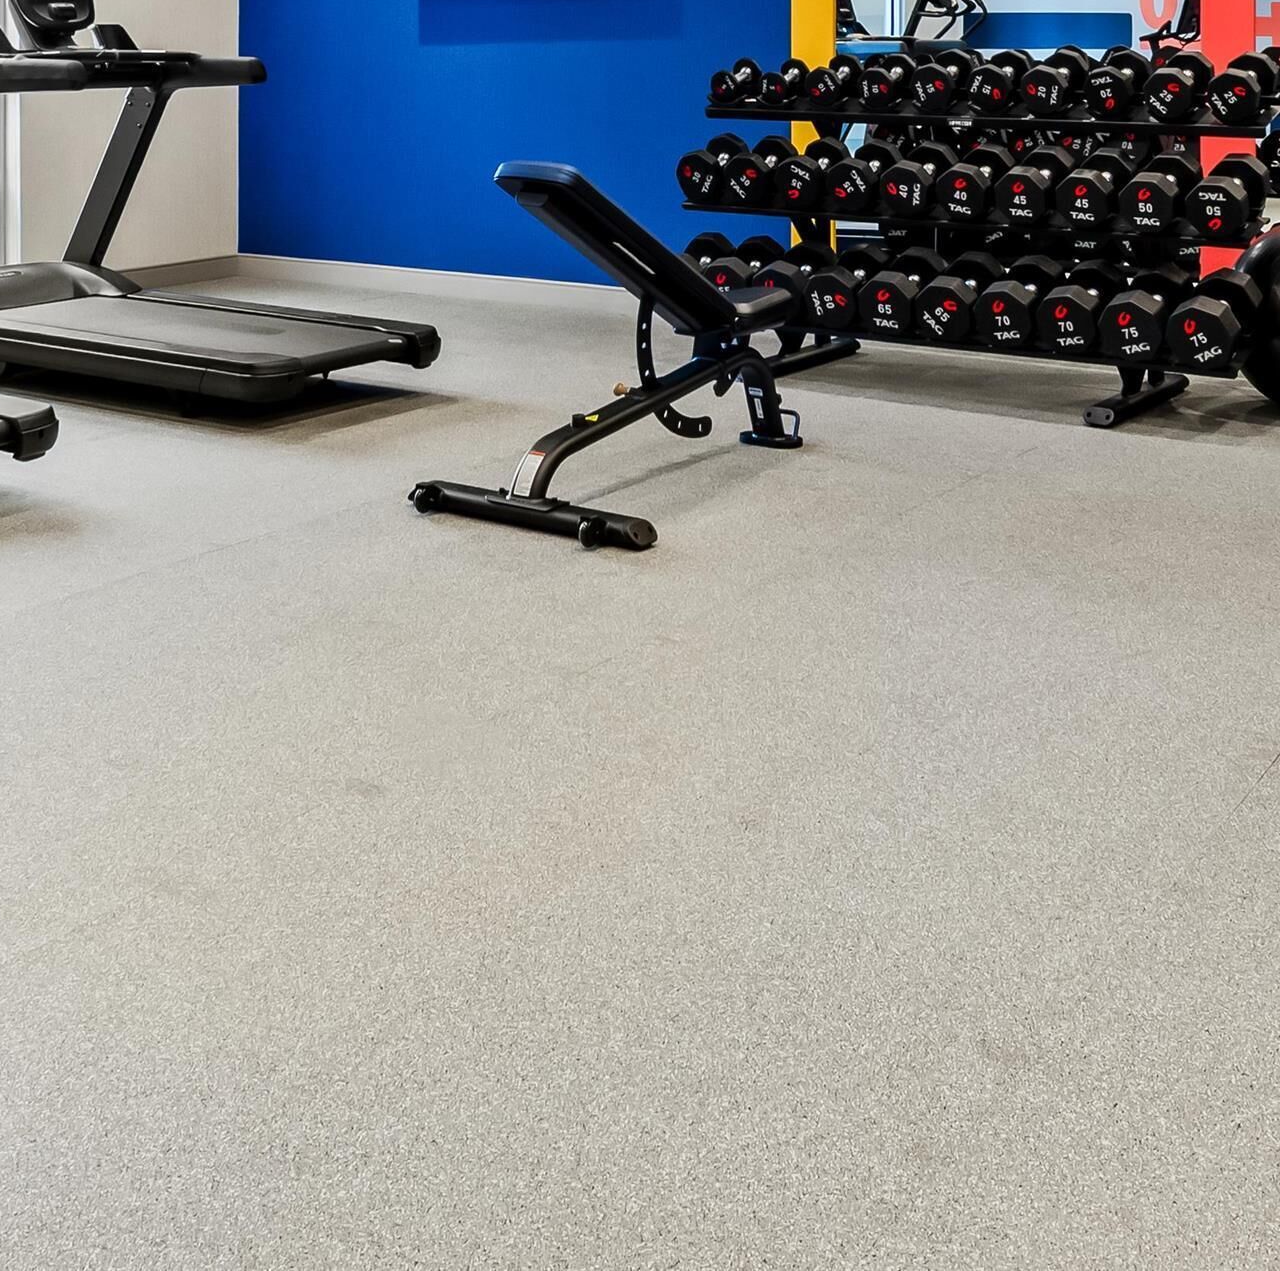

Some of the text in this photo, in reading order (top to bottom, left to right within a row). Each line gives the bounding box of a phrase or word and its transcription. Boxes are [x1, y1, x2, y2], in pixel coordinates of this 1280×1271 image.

[970, 74, 983, 94] TAG
[1091, 76, 1113, 86] TAG
[871, 84, 880, 94] 10
[914, 81, 928, 102] TAG
[926, 83, 935, 95] 15
[982, 84, 992, 96] 15
[1037, 85, 1047, 98] 20
[1049, 84, 1059, 106] TAG
[1099, 88, 1113, 98] 20
[1159, 89, 1174, 103] 25
[1223, 90, 1238, 105] 25
[1148, 96, 1168, 115] TAG
[1209, 93, 1228, 116] TAG
[692, 171, 702, 183] 30
[790, 164, 811, 181] TAG
[701, 174, 713, 193] TAG
[739, 174, 751, 187] 30
[791, 178, 802, 189] 35
[850, 169, 867, 193] TAG
[729, 179, 747, 199] TAG
[842, 181, 855, 194] 35
[898, 184, 908, 199] 40
[912, 183, 921, 206] TAG
[953, 190, 968, 201] 40
[1013, 195, 1027, 205] 45
[1198, 191, 1227, 202] TAG
[948, 202, 972, 215] TAG
[1074, 198, 1089, 209] 45
[1138, 202, 1153, 214] 50
[1009, 208, 1033, 218] TAG
[1069, 211, 1095, 221] TAG
[1205, 205, 1222, 217] 50
[1133, 216, 1161, 227] TAG
[810, 290, 824, 316] TAG
[823, 295, 835, 310] 60
[877, 303, 893, 315] 65
[934, 306, 951, 323] 65
[995, 315, 1010, 327] 70
[872, 317, 899, 329] TAG
[922, 311, 945, 336] TAG
[1058, 321, 1074, 333] 70
[993, 330, 1021, 341] TAG
[1121, 328, 1139, 340] 75
[1189, 332, 1208, 348] 75
[1056, 335, 1085, 347] TAG
[1121, 342, 1151, 355] TAG
[1194, 345, 1223, 363] TAG
